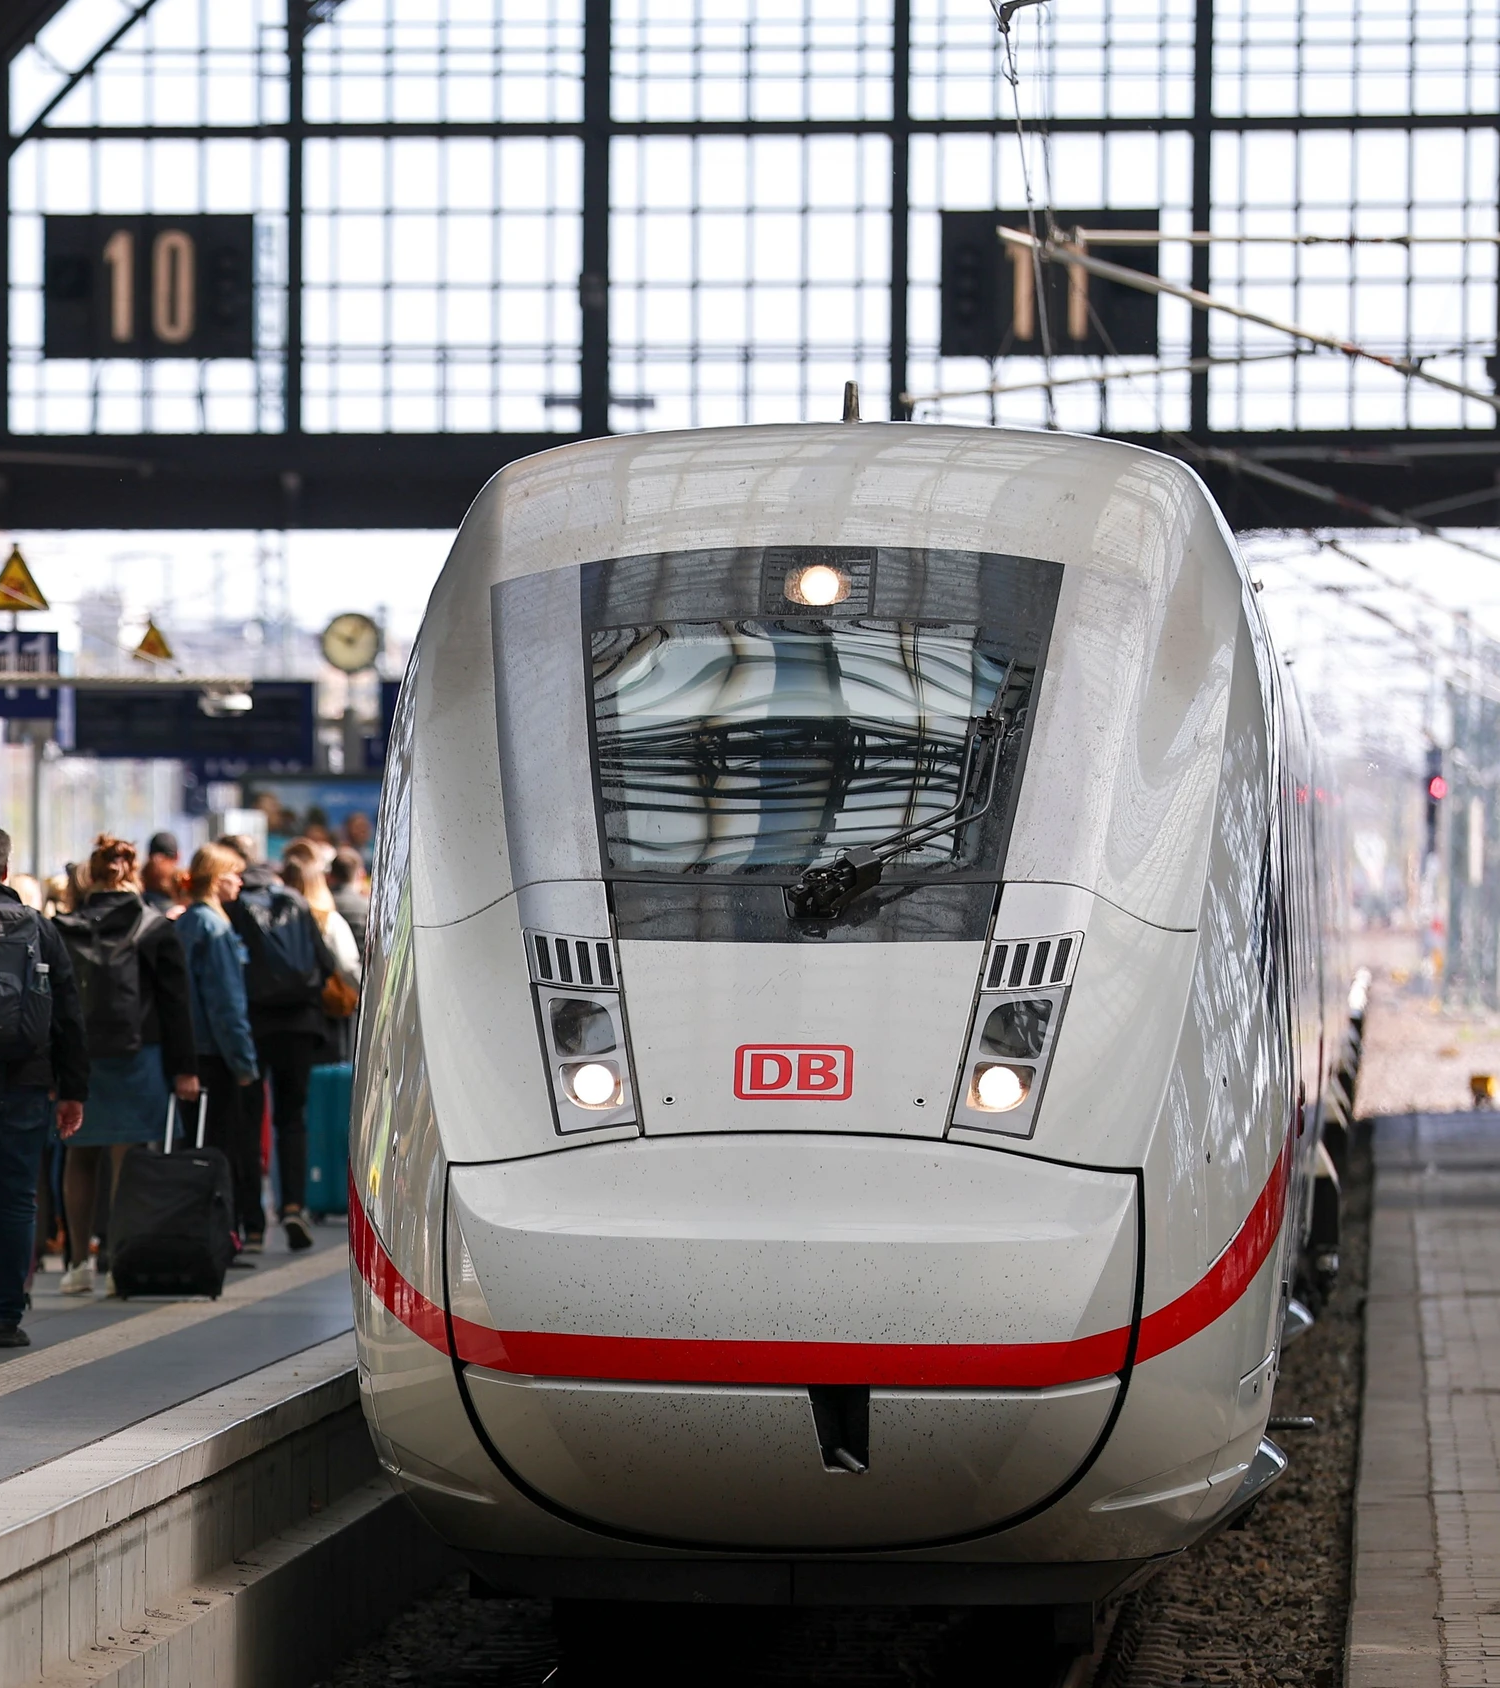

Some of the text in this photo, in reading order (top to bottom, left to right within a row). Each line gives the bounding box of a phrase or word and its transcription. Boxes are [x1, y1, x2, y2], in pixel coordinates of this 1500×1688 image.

[103, 229, 195, 344] 10
[1005, 225, 1088, 342] 11
[748, 1051, 840, 1092] DB
